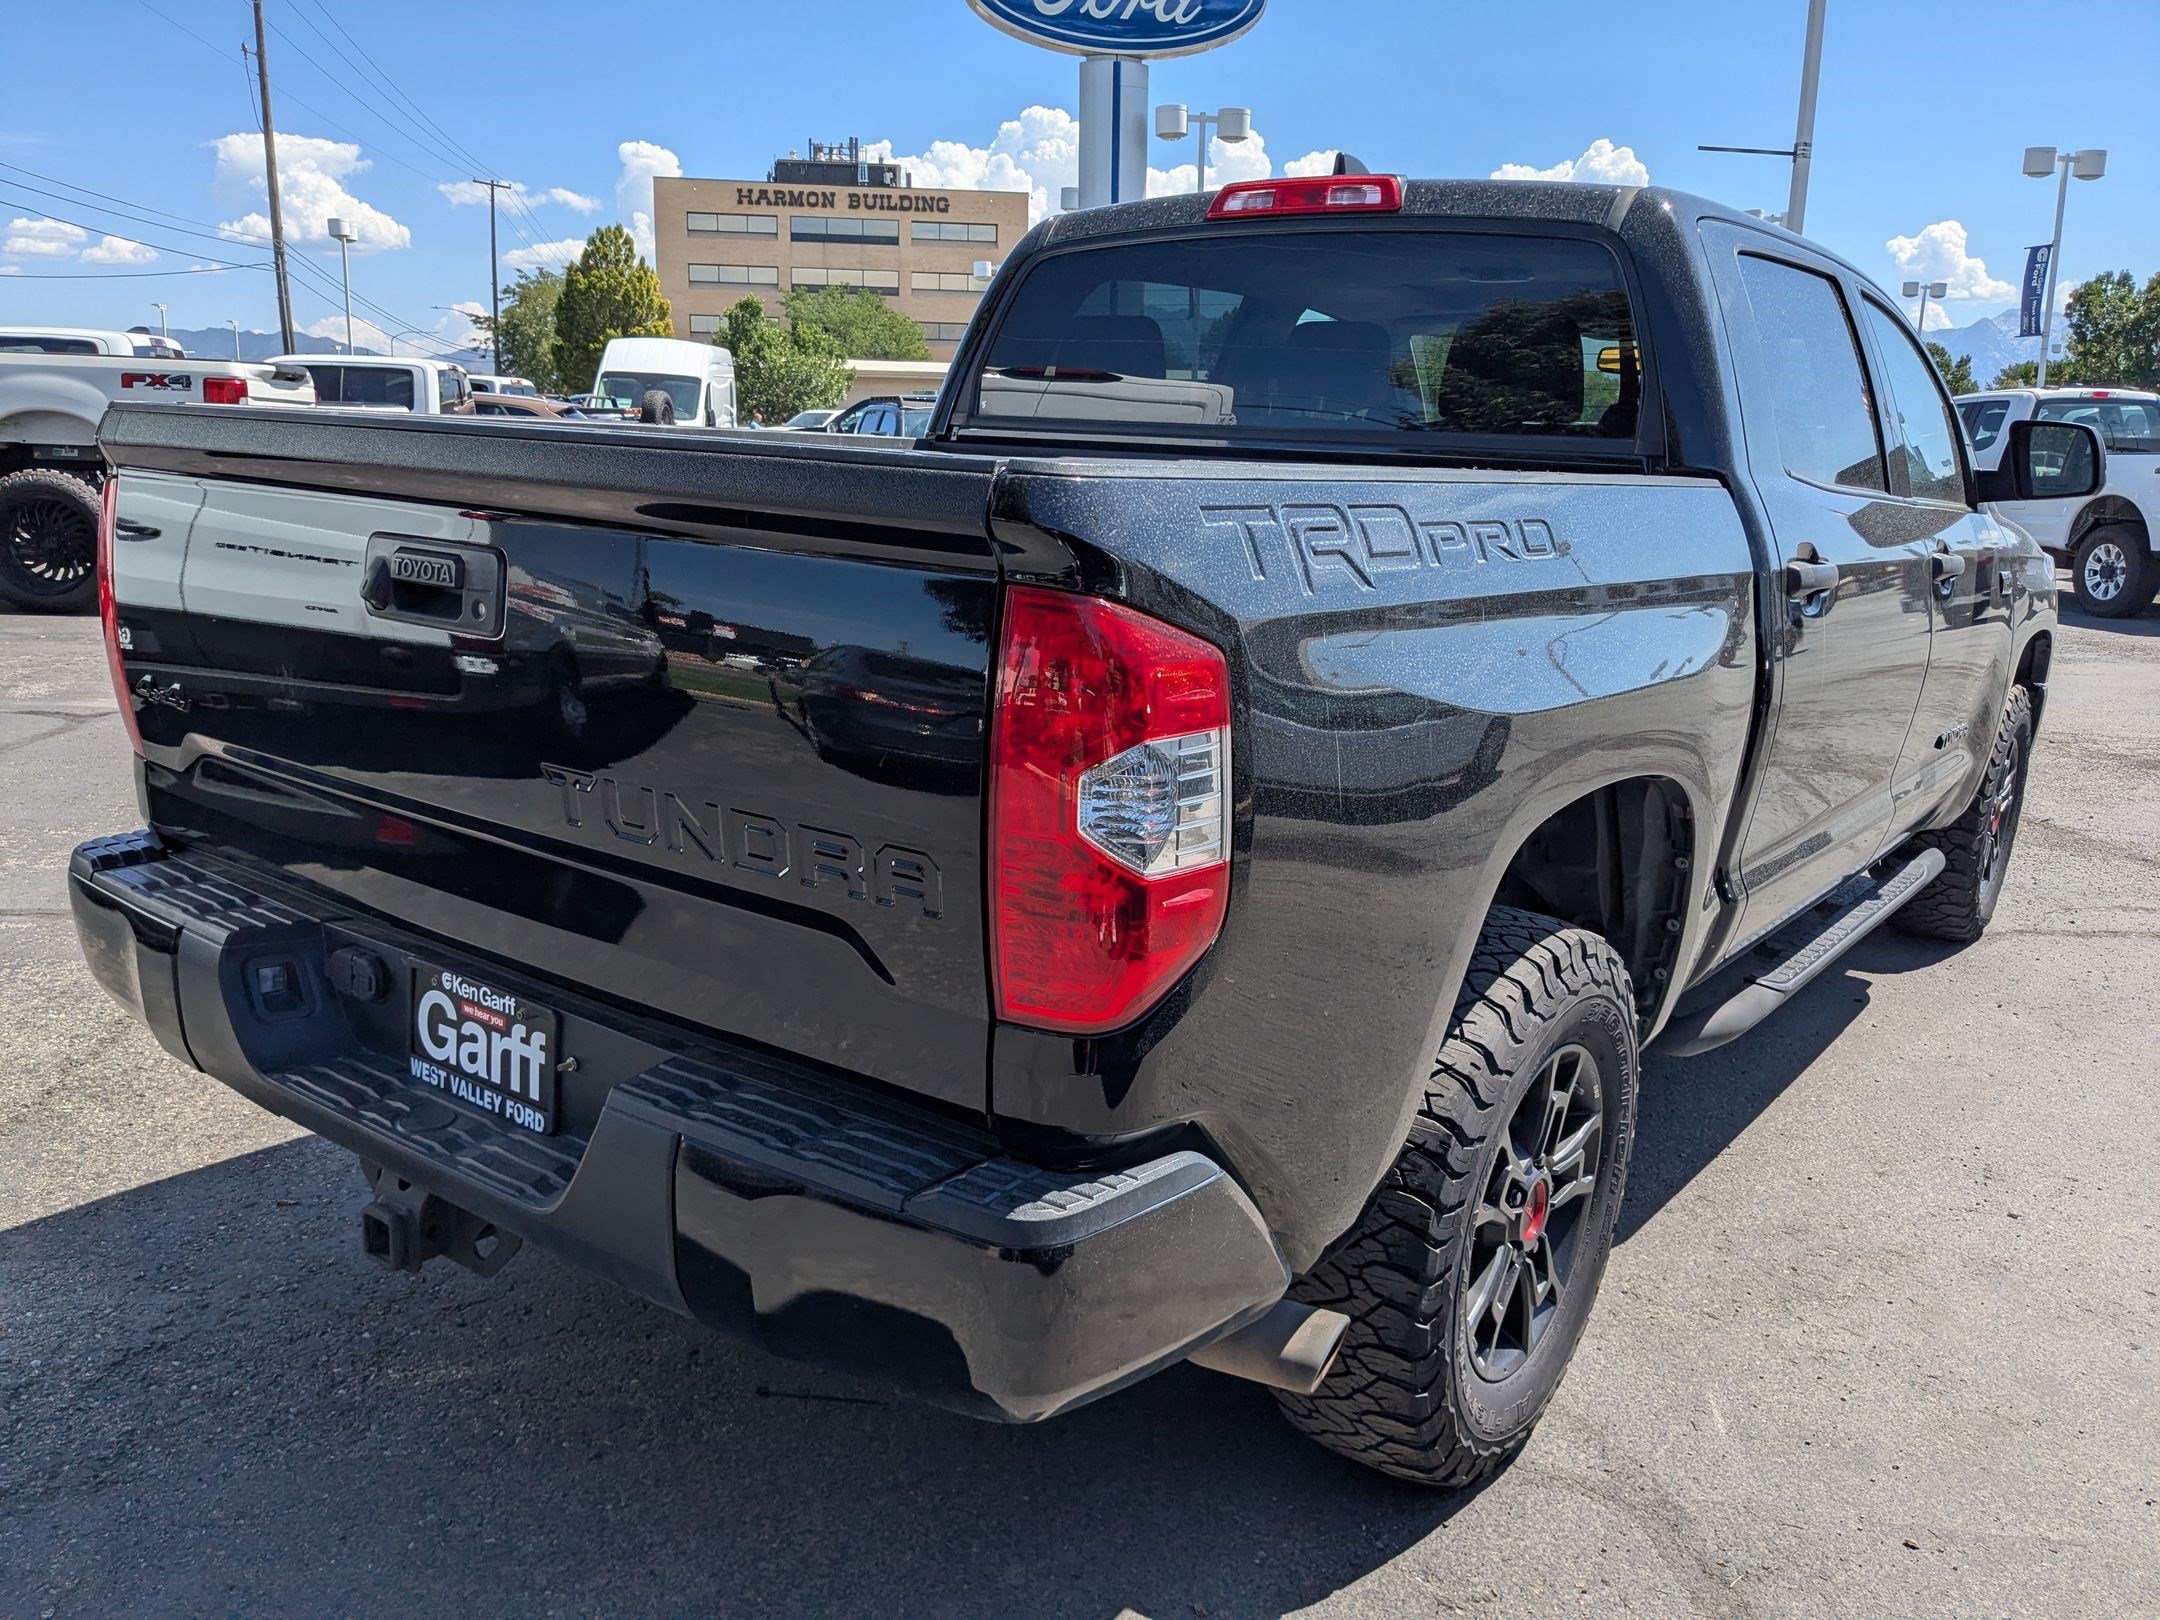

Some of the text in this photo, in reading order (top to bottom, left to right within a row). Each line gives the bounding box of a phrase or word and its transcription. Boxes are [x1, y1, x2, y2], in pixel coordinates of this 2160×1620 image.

[737, 188, 950, 213] HARMON BUILDING
[2032, 263, 2041, 287] Ford
[121, 372, 192, 388] FX4
[1199, 503, 1558, 598] TRD PRO
[393, 557, 453, 583] TOYOTA
[540, 761, 944, 919] TUNDRA
[453, 973, 516, 1016] Ken Garff
[463, 1004, 504, 1027] we hear you
[418, 989, 546, 1102] Garff
[410, 1057, 545, 1133] WEST VALLEY FORD
